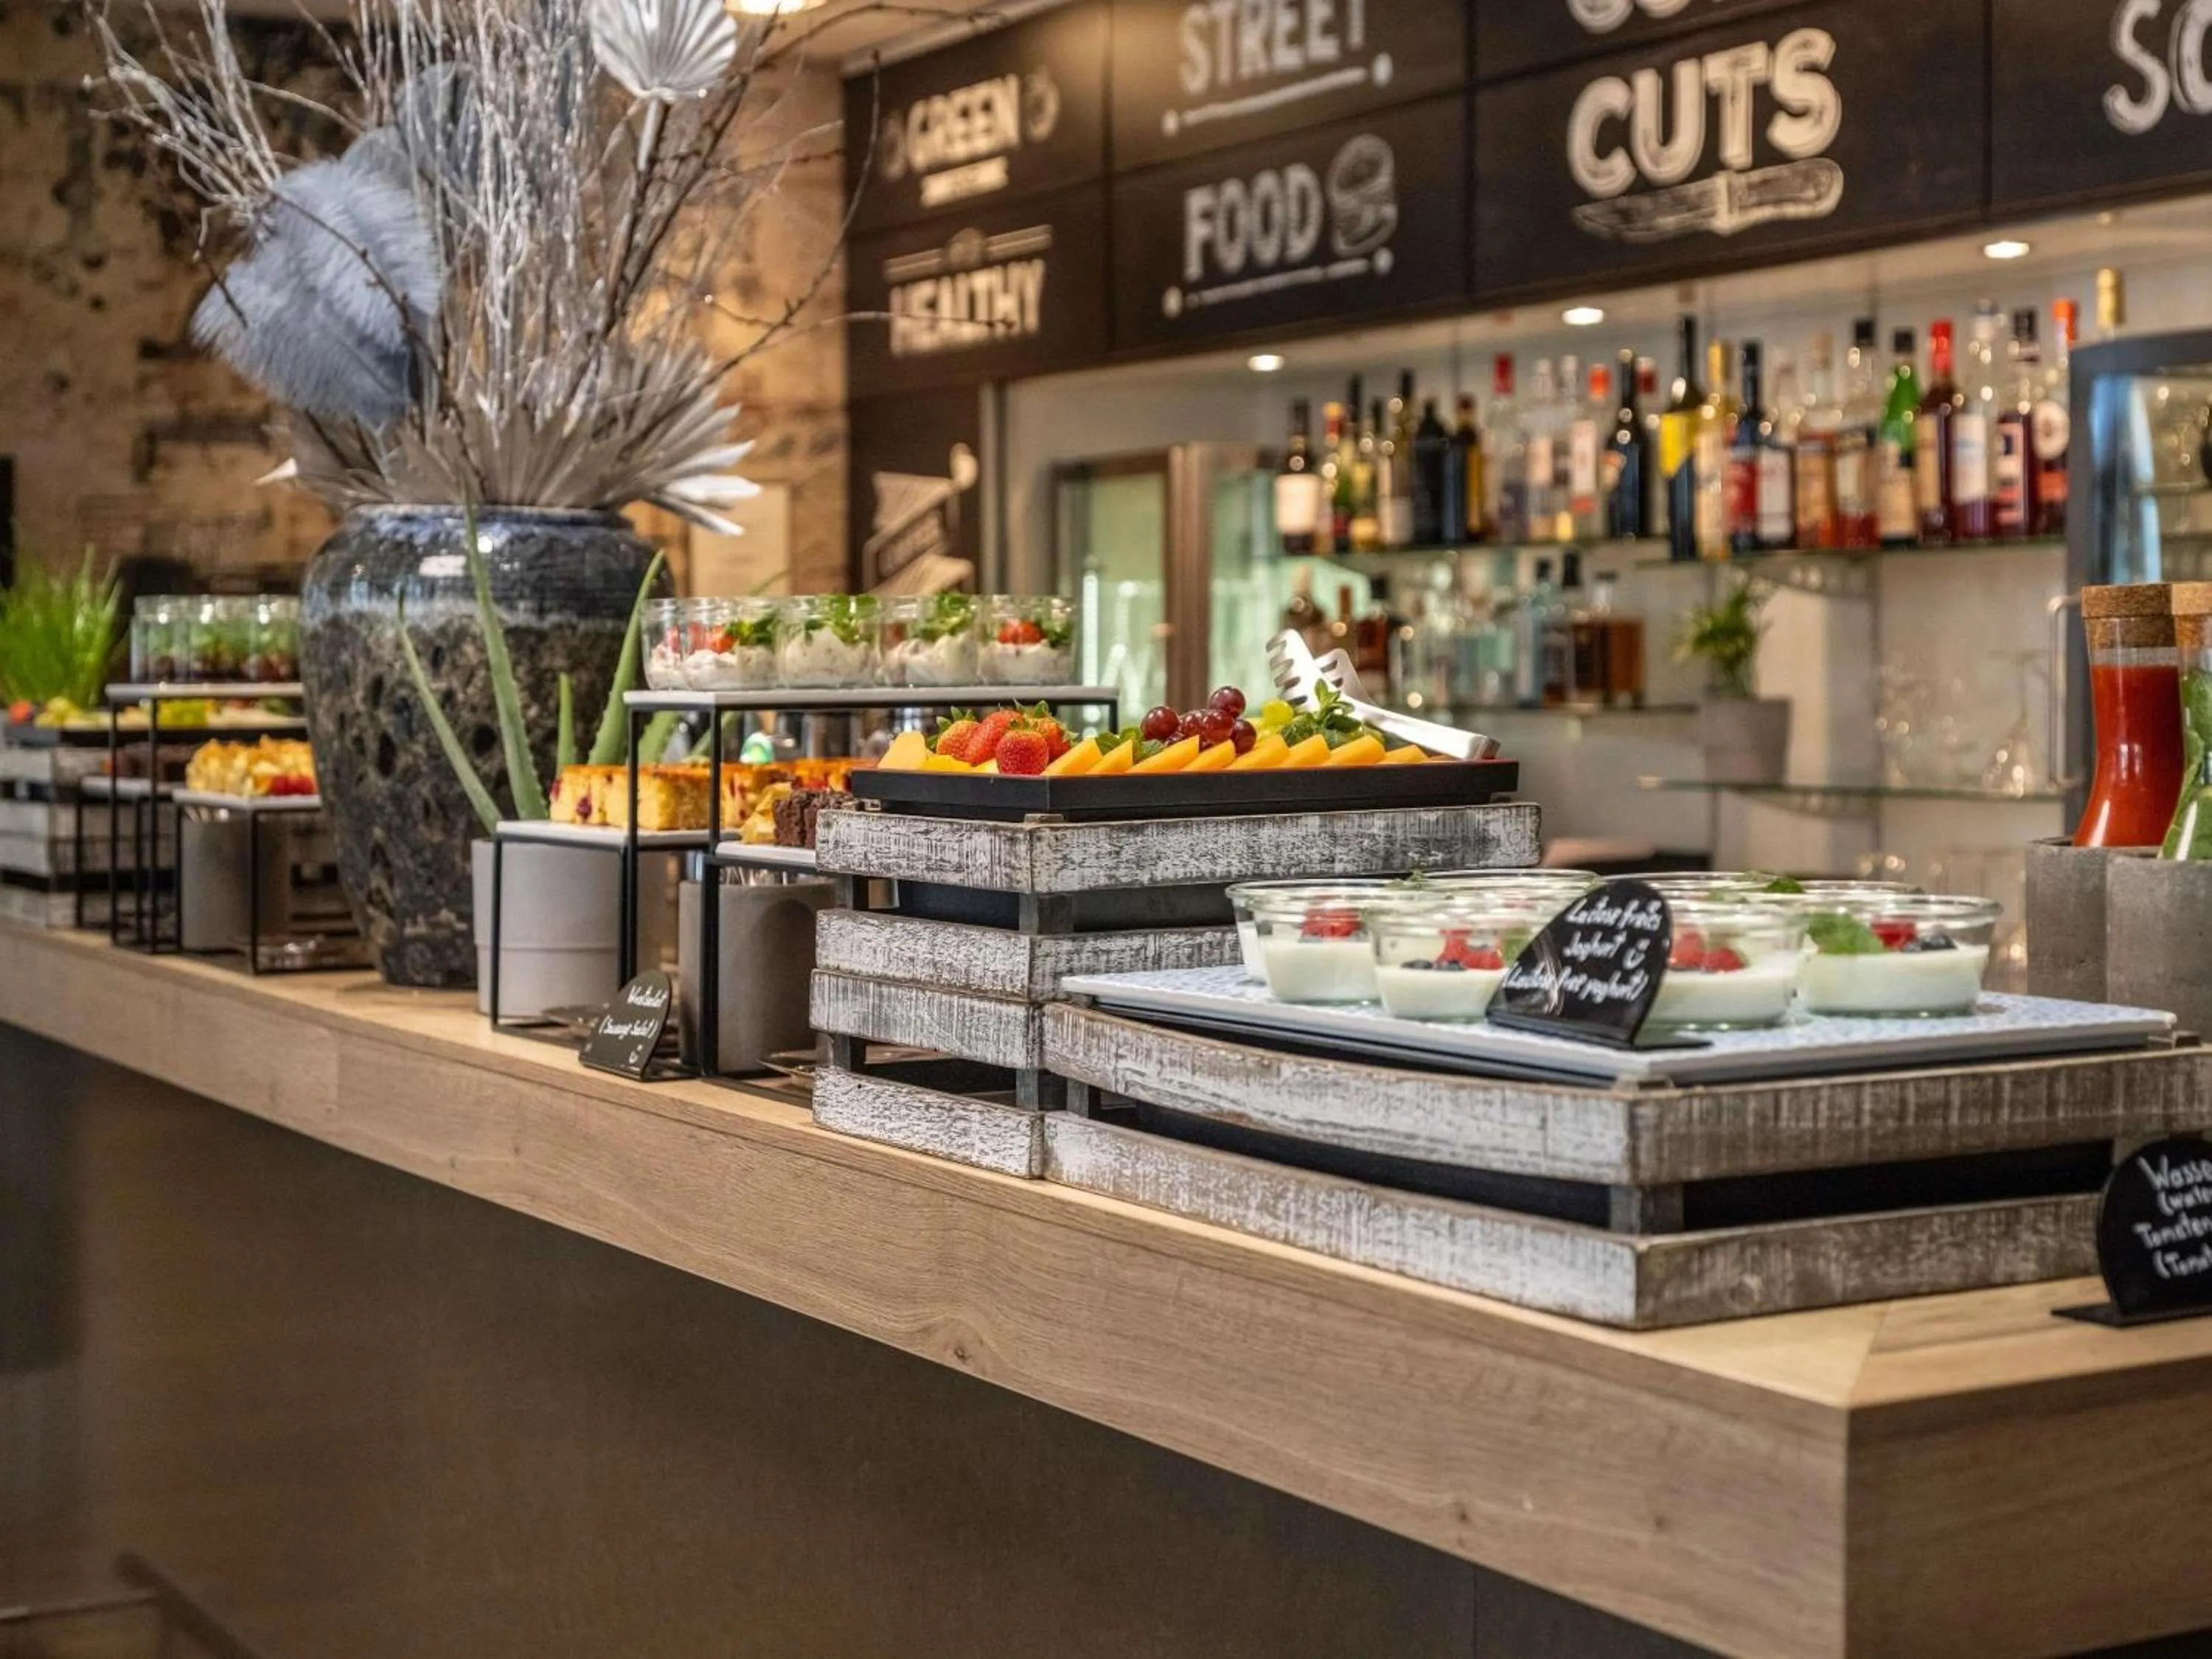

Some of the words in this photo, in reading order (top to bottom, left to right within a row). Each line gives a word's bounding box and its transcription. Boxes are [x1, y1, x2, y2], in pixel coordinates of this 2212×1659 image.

[1180, 0, 1364, 95] STREET
[906, 73, 1020, 174] GREEN
[1567, 28, 1842, 198] CUTS
[1183, 161, 1324, 282] FOOD
[888, 258, 1045, 357] HEALTHY
